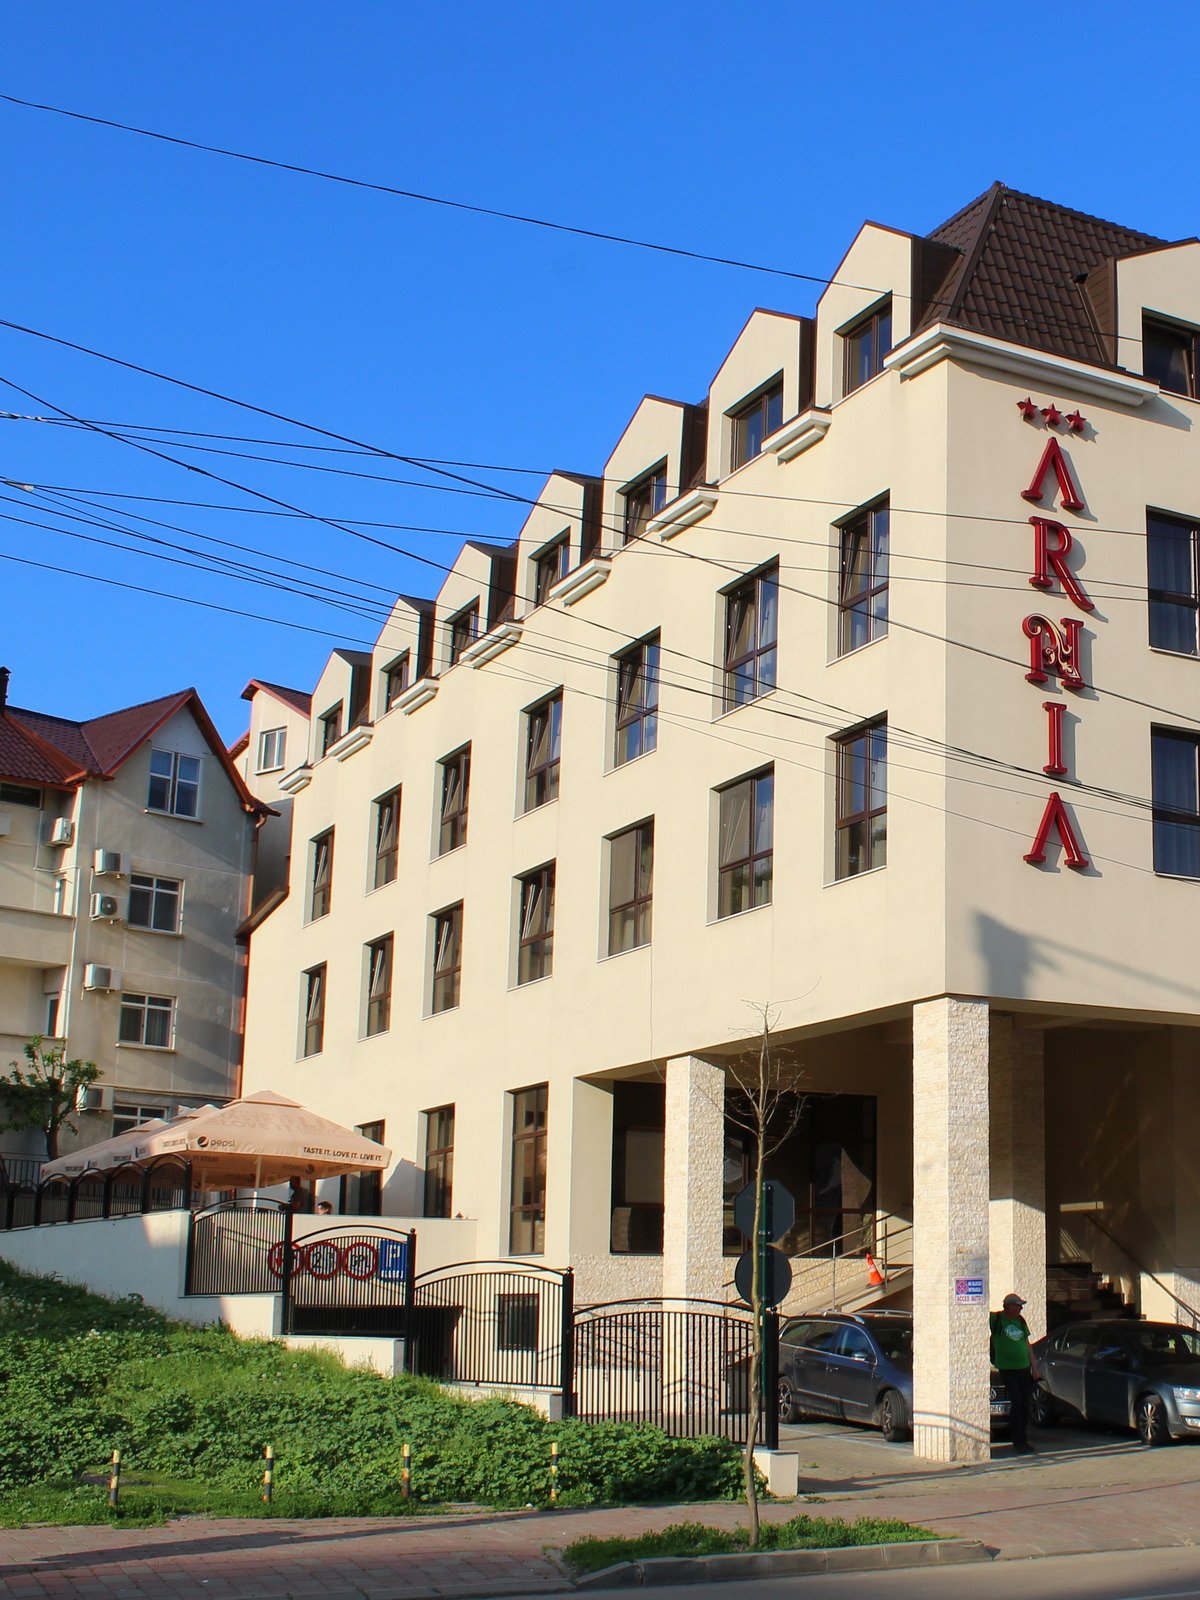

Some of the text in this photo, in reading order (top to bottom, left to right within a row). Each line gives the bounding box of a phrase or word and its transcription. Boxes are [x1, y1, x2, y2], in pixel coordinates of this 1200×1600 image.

[210, 1138, 236, 1148] pepsi
[303, 1147, 323, 1155] TASTE
[333, 1150, 350, 1158] LOVE
[360, 1153, 375, 1161] LIVE
[375, 1154, 383, 1162] IT.
